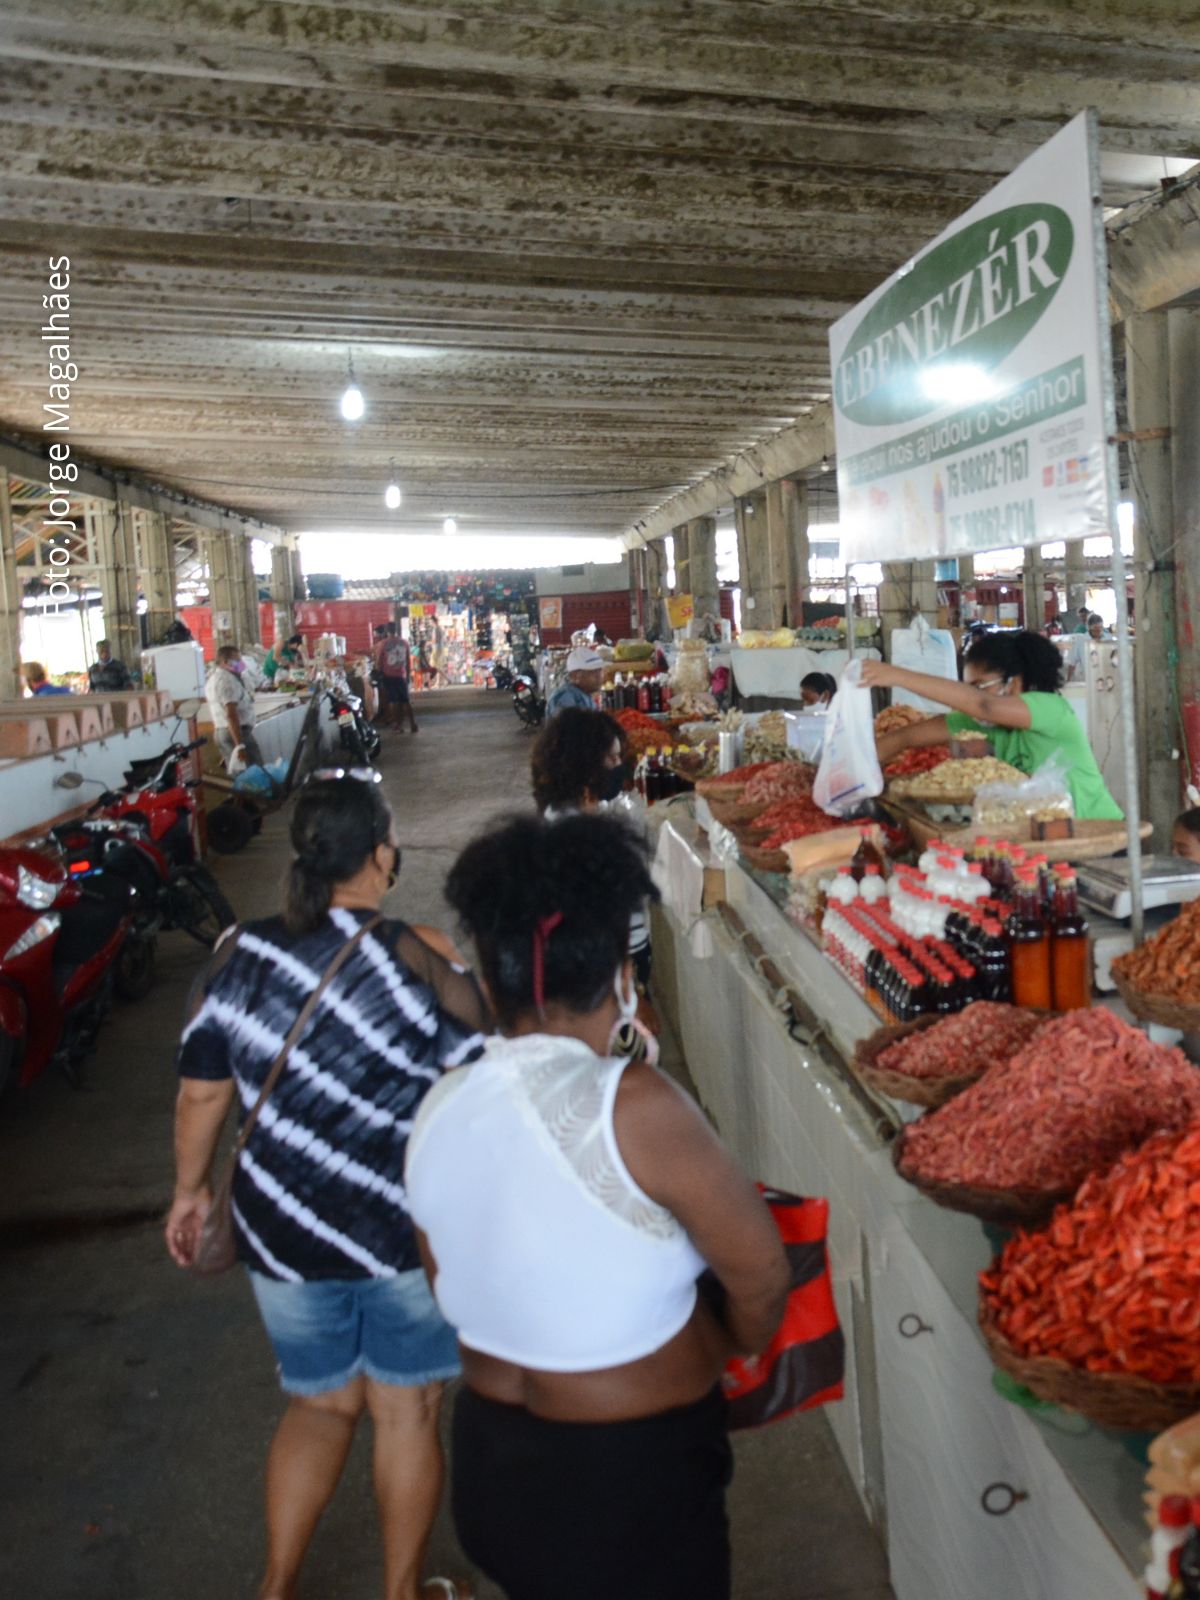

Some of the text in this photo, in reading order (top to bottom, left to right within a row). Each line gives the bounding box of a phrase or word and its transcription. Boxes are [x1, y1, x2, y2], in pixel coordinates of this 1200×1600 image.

[839, 219, 1061, 408] EBENEZÉR
[888, 441, 914, 466] nos
[917, 417, 972, 463] ajudou
[976, 411, 990, 433] o
[995, 366, 1083, 426] Senhor
